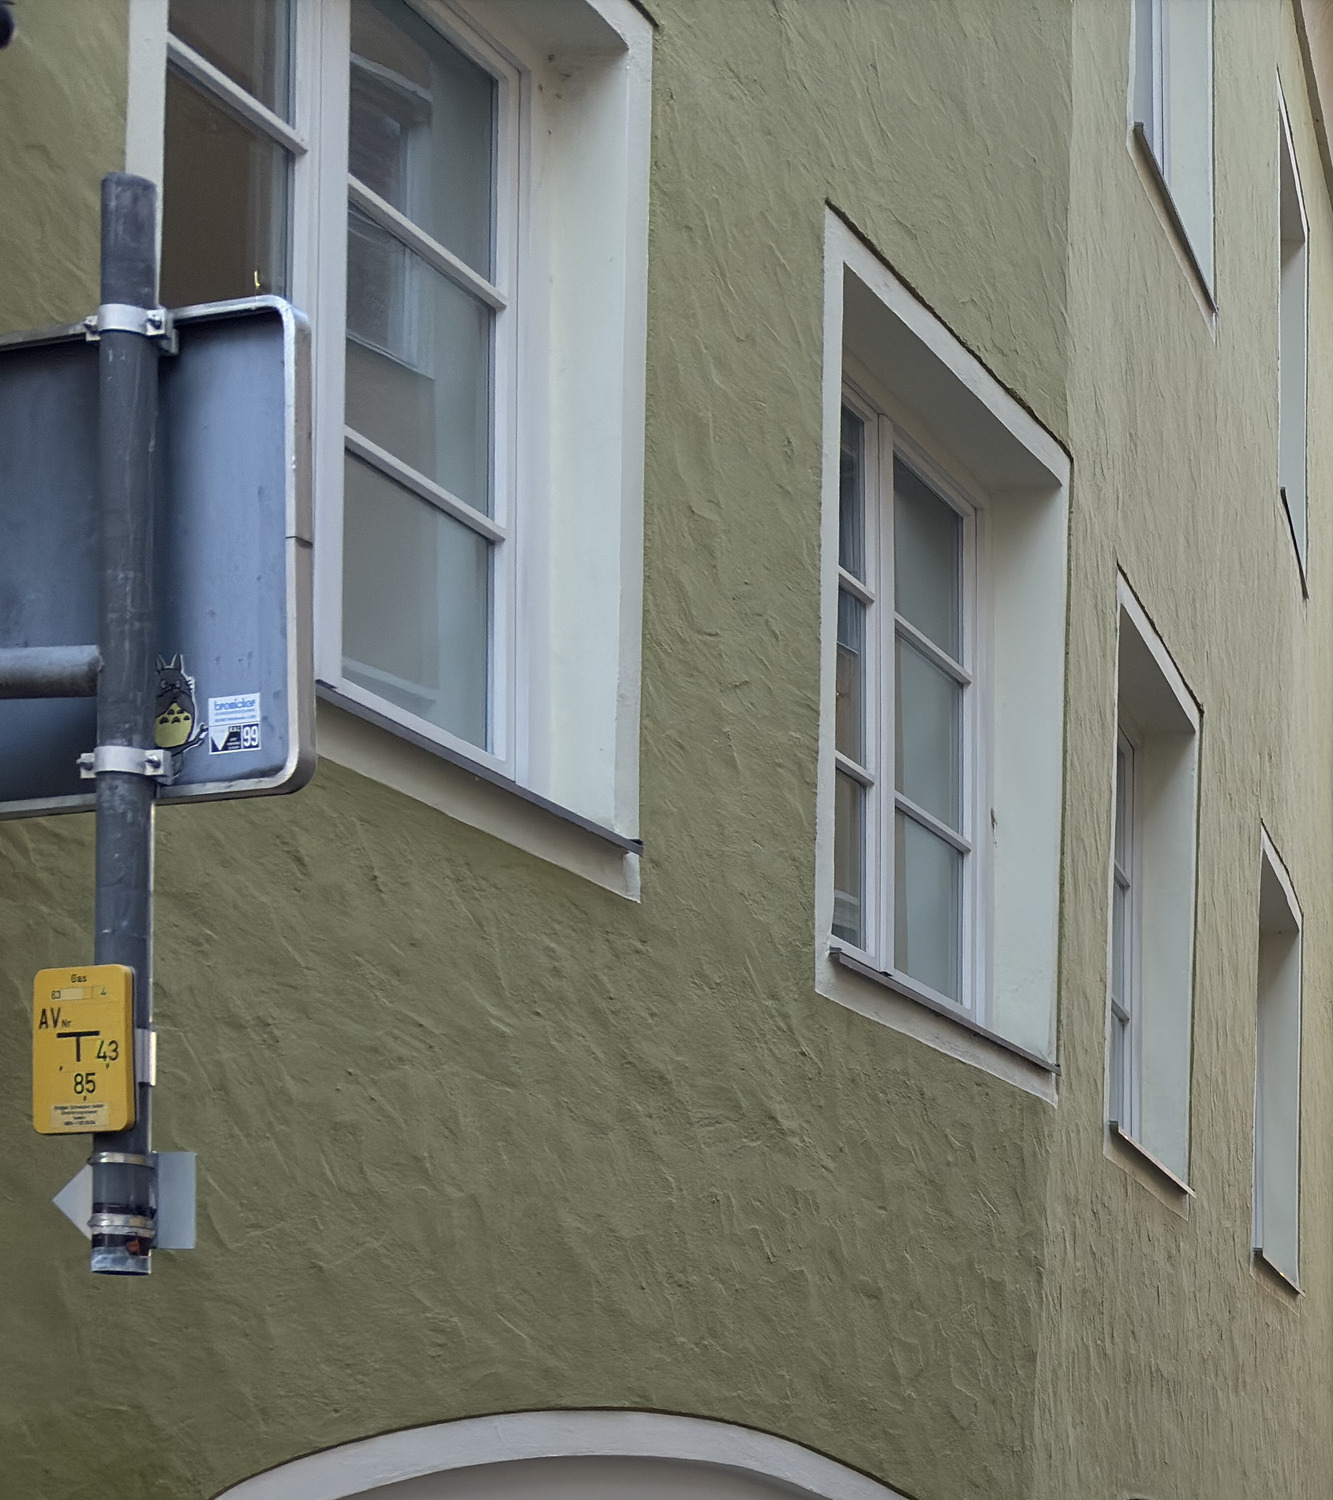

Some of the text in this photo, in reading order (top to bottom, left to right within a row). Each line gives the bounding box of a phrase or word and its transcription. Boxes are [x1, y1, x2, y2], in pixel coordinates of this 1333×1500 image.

[243, 726, 258, 746] 99
[71, 974, 87, 983] Gas
[97, 1040, 119, 1061] 43
[74, 1073, 96, 1095] 85
